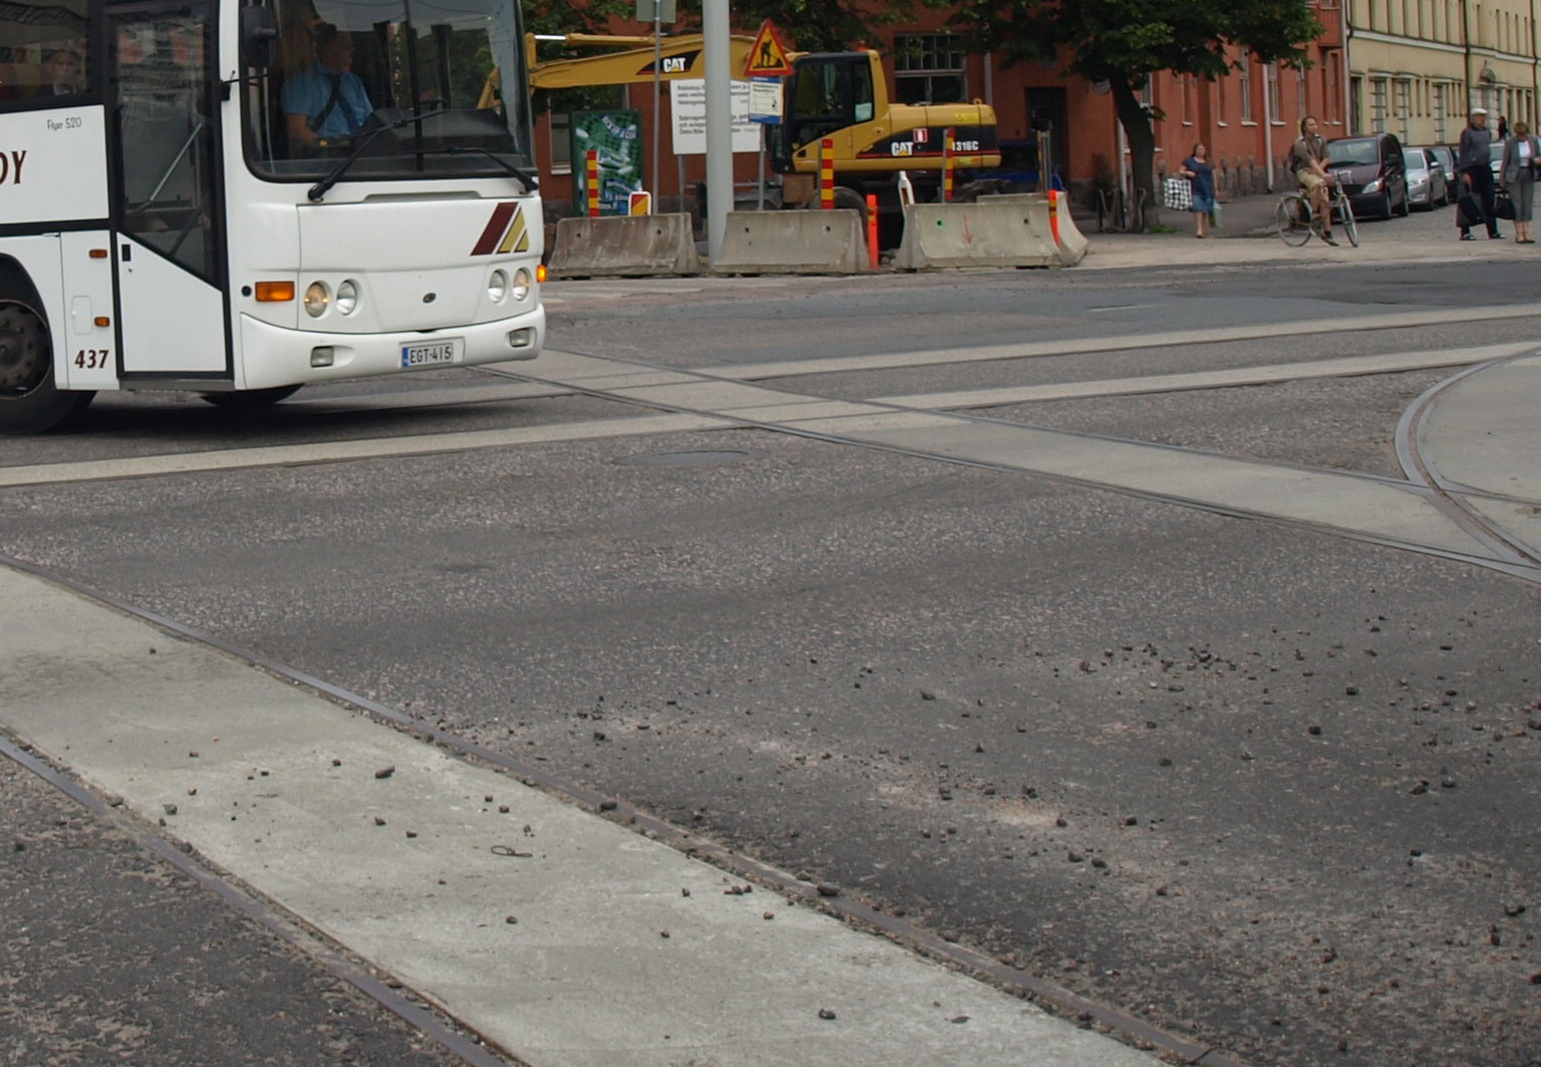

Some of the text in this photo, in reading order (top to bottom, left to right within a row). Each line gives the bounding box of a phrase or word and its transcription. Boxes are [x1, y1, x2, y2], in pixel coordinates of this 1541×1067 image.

[663, 57, 686, 73] CAT
[65, 116, 82, 129] 520
[891, 141, 914, 157] CAT
[74, 349, 110, 369] 437
[410, 346, 452, 364] EGT-415
